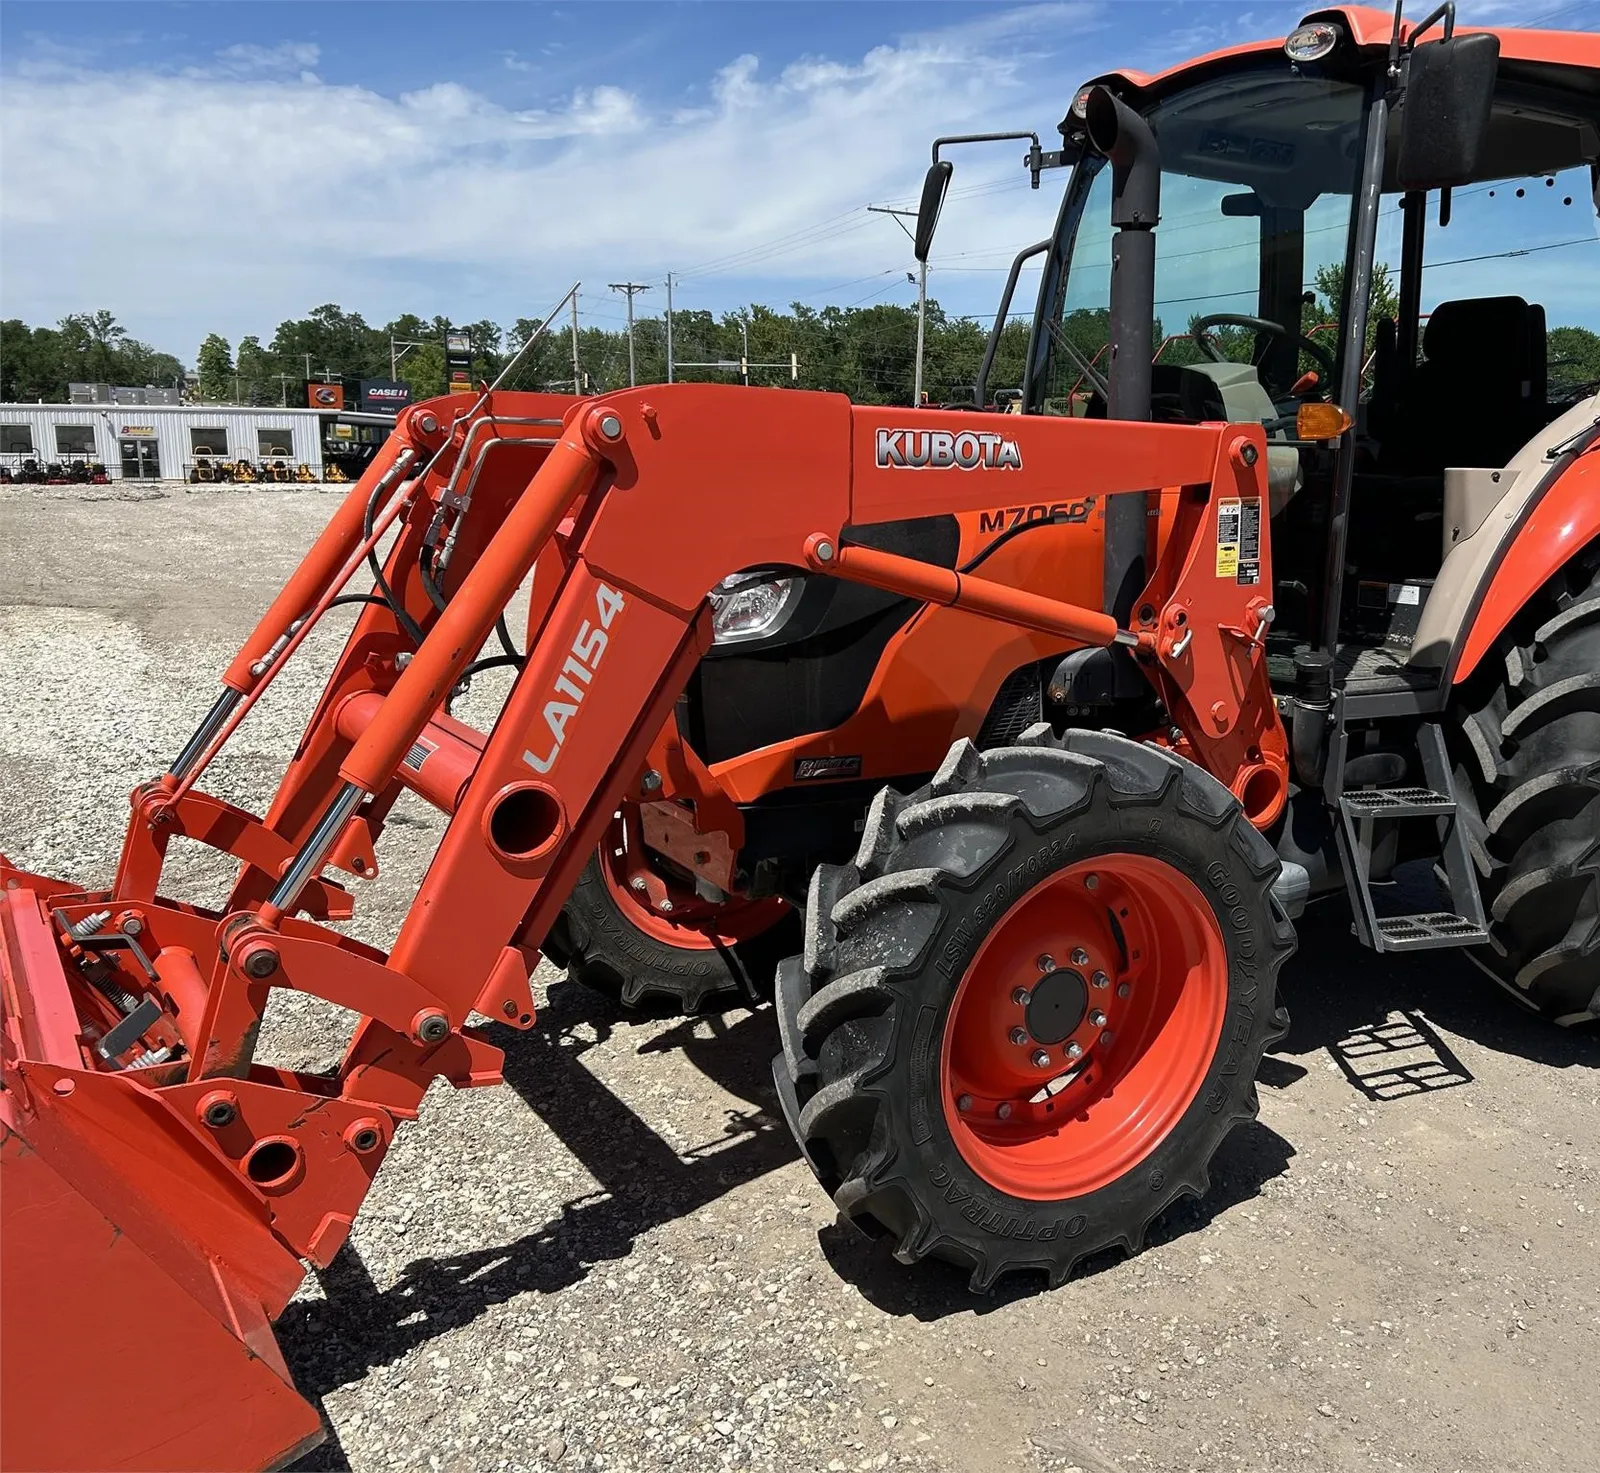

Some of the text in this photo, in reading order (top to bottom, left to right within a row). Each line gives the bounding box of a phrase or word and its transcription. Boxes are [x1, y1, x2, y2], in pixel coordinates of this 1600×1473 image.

[368, 388, 398, 396] CASE
[876, 429, 1022, 470] KUBOTA
[522, 582, 626, 774] LA1154
[591, 901, 713, 977] OPTITRAC
[934, 917, 975, 980] LSW
[1205, 860, 1259, 1114] GOODYEAR
[928, 1162, 1089, 1242] OPTITRAC
